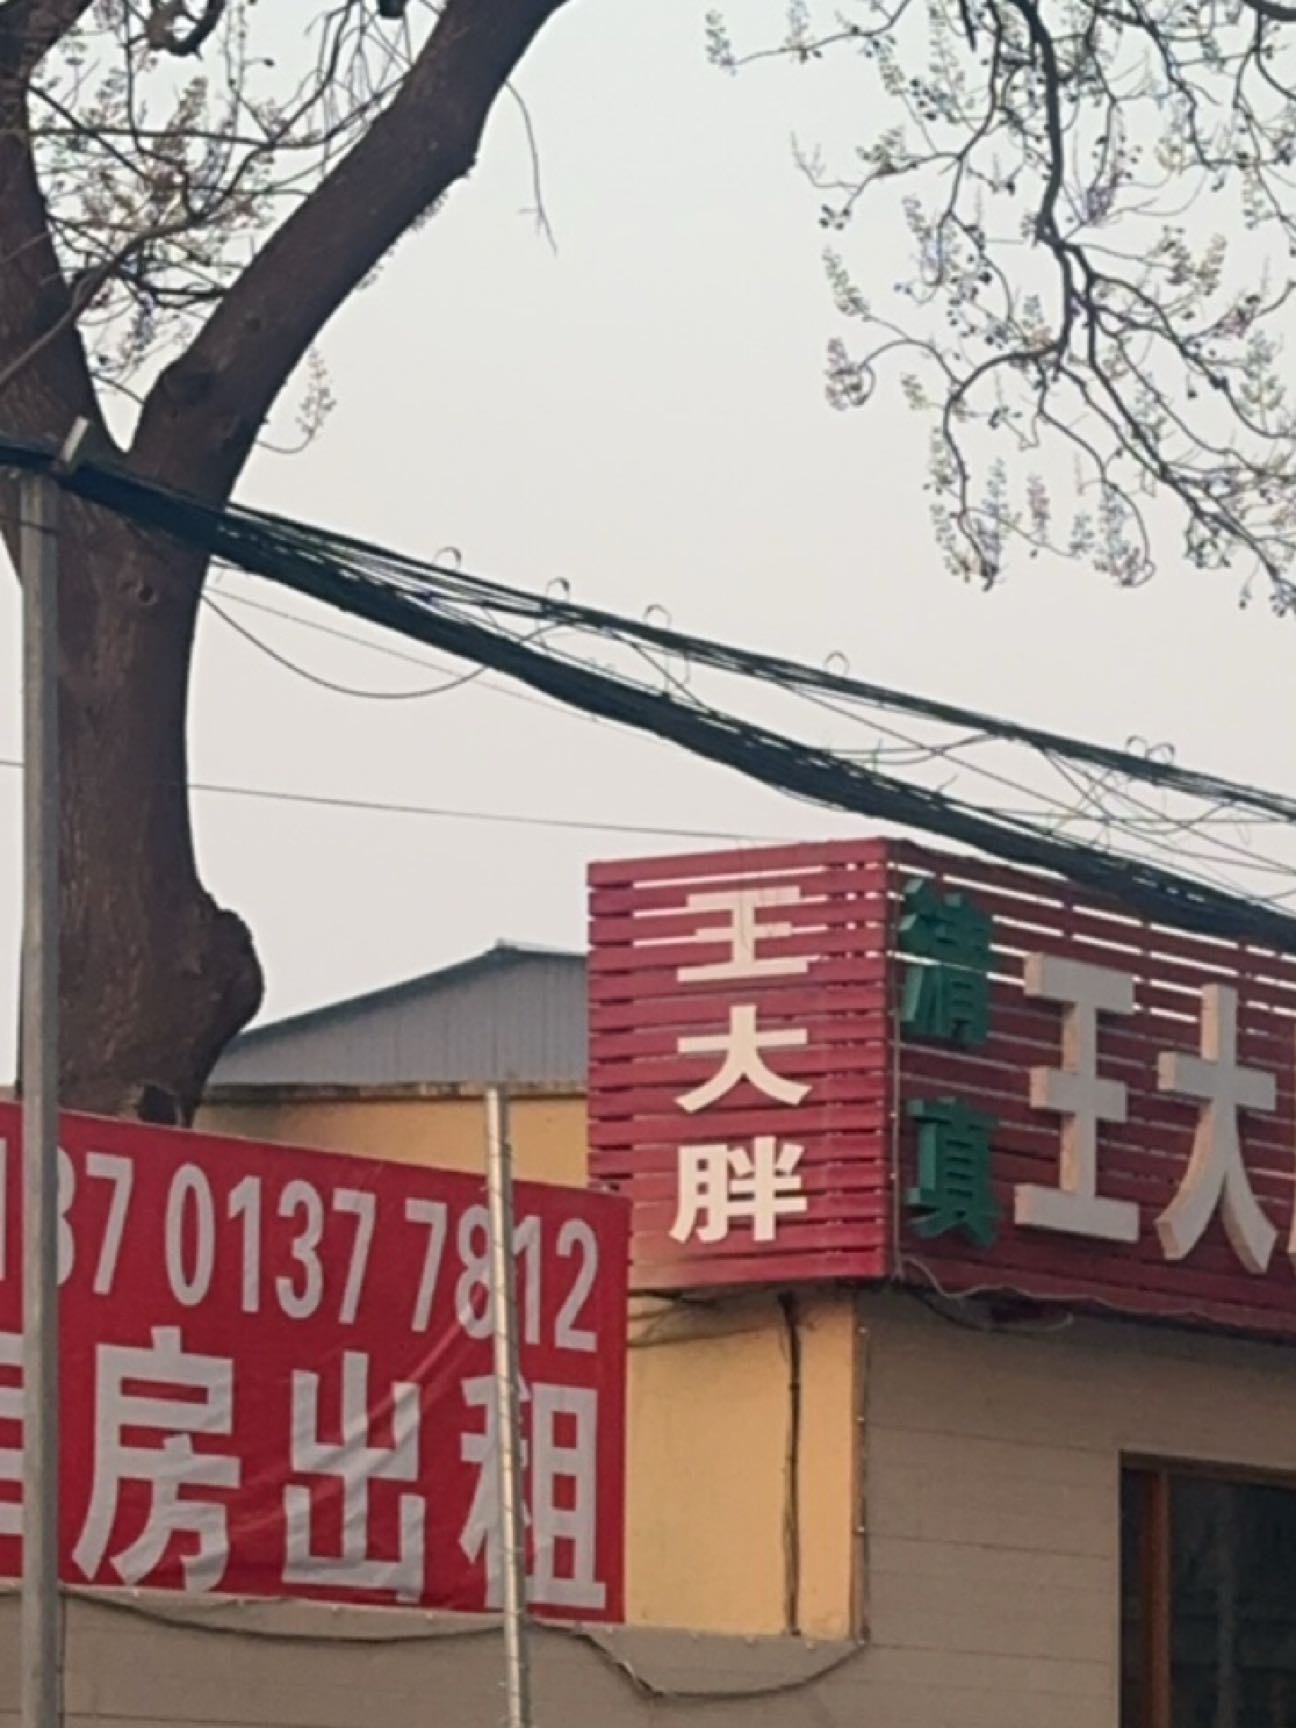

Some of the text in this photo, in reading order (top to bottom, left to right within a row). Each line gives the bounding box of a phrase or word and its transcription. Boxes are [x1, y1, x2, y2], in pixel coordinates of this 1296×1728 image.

[671, 885, 811, 1242] 王大胖
[899, 877, 1000, 1247] 清真
[0, 1326, 606, 1610] 房出租
